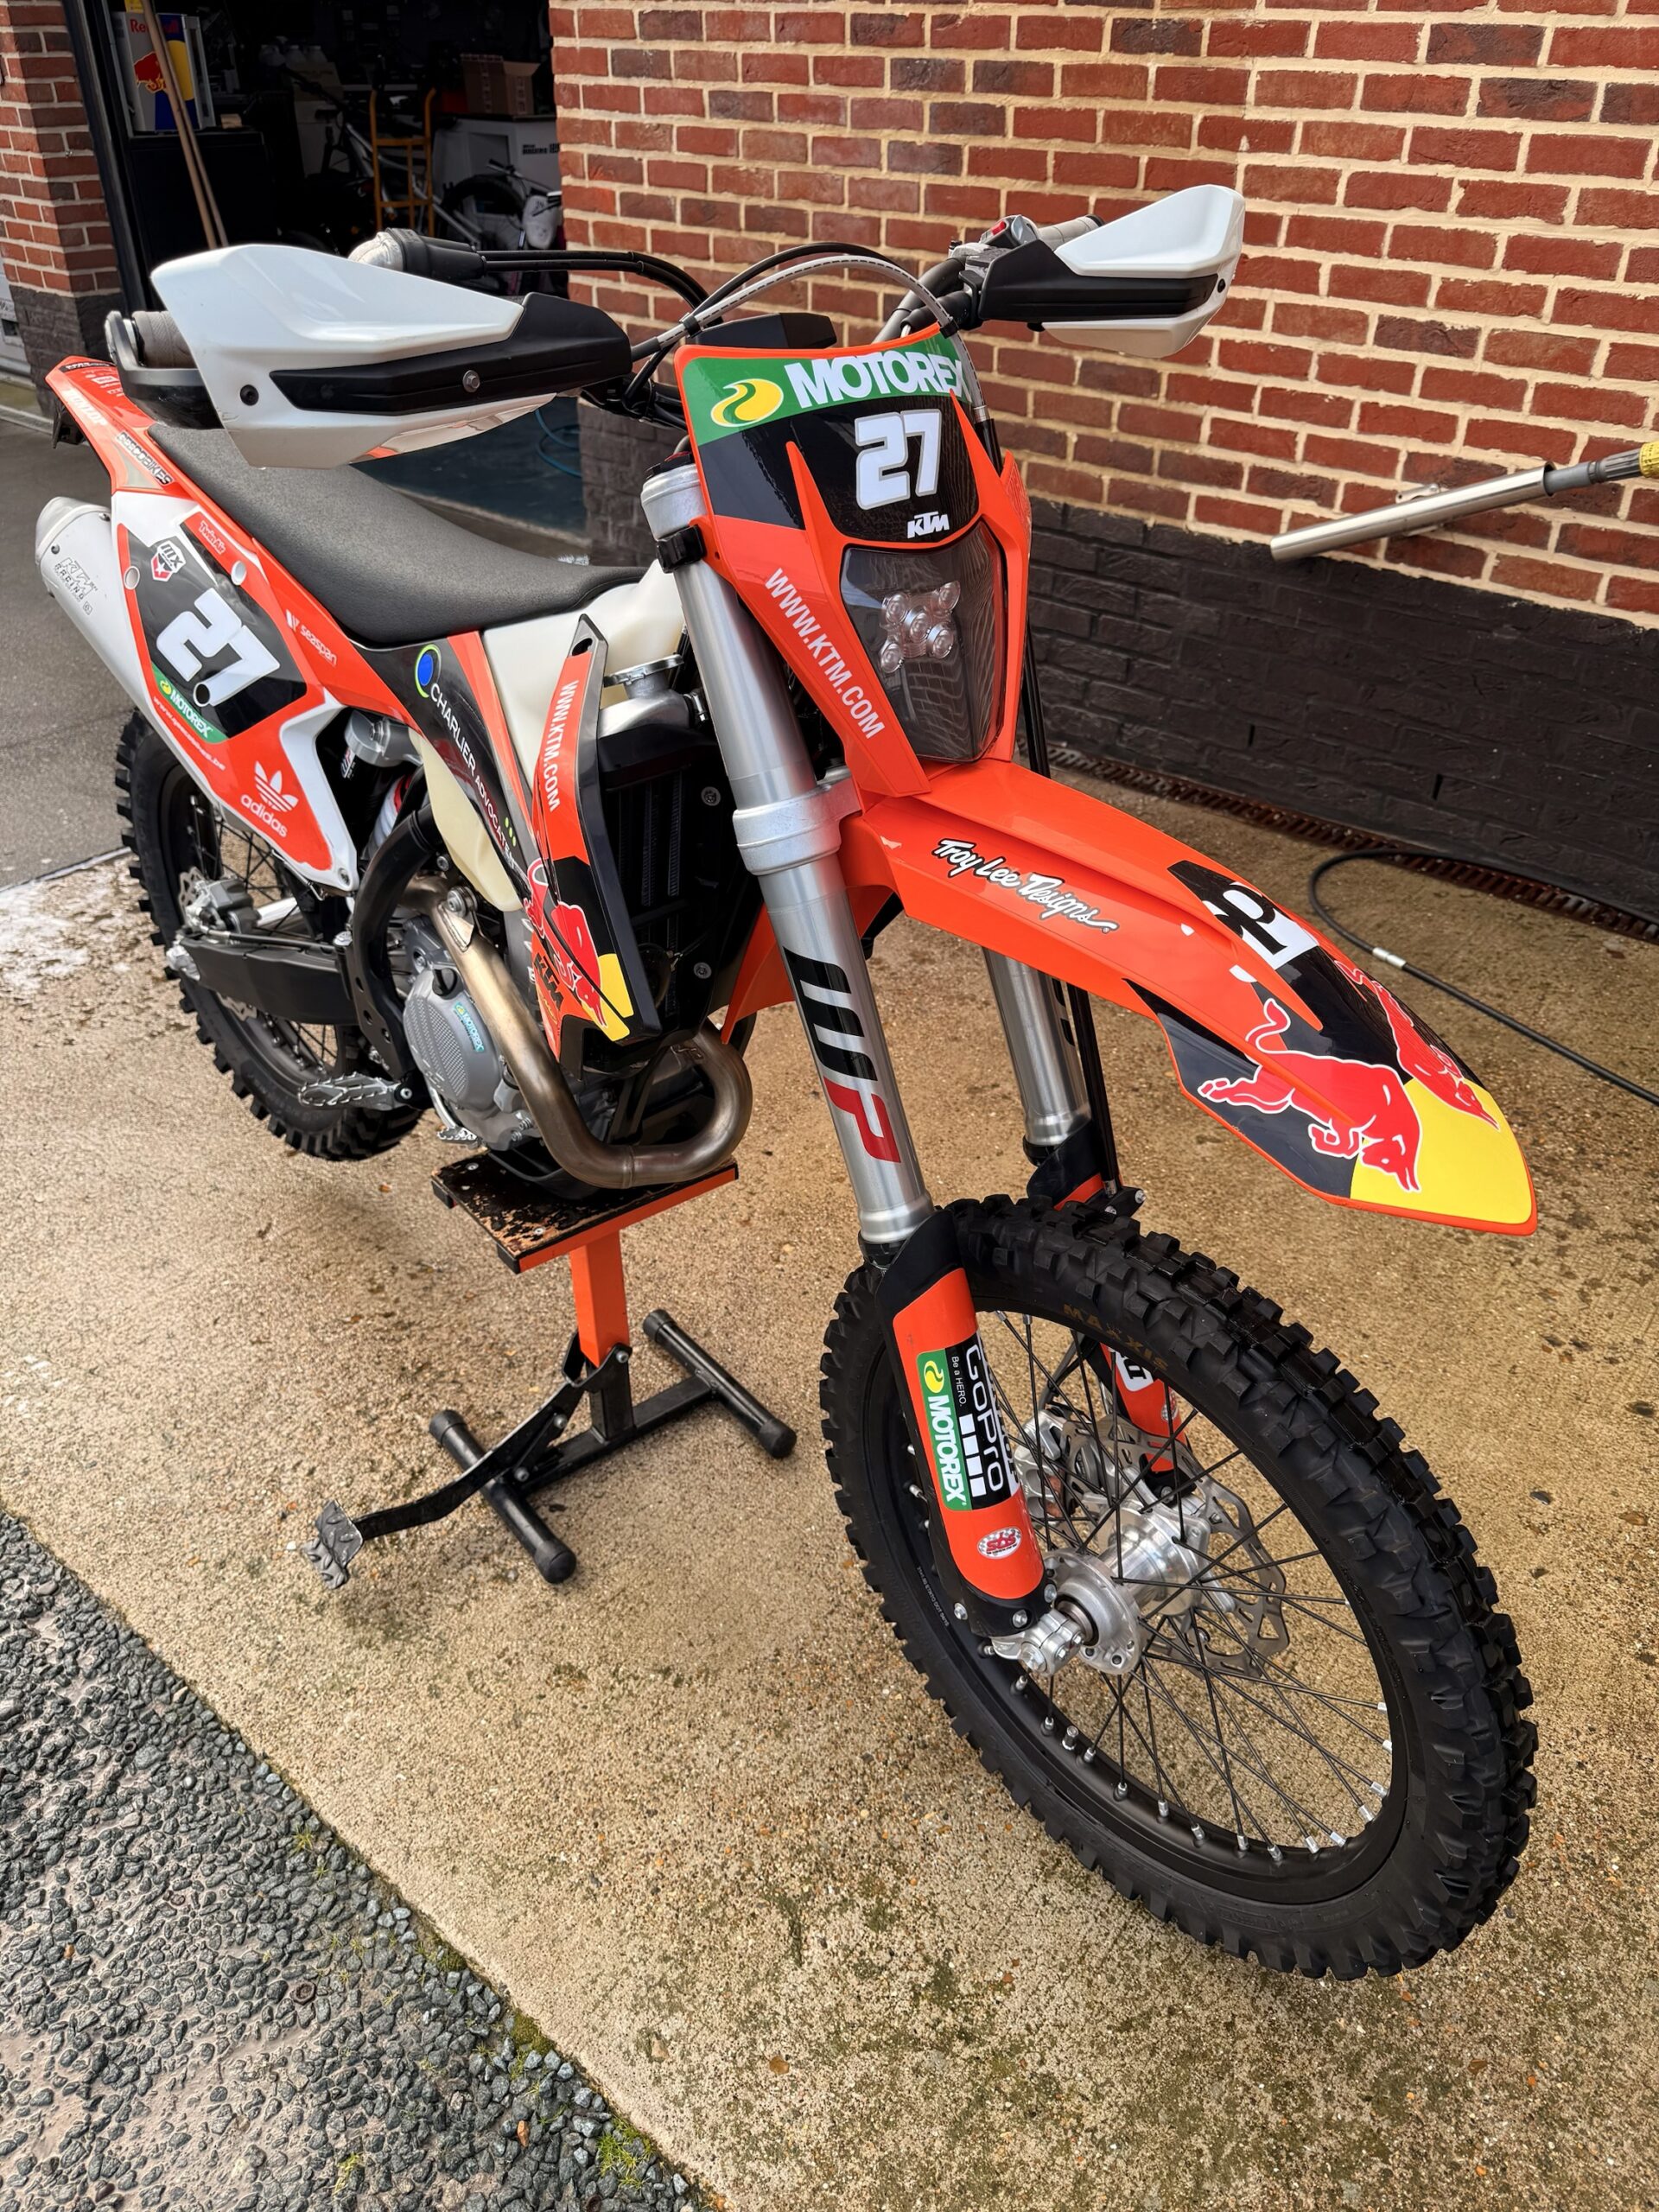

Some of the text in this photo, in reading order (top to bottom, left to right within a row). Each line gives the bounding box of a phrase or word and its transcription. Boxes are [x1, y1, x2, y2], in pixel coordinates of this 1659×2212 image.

[130, 19, 149, 33] Re
[784, 350, 972, 409] MOTOREX
[855, 409, 942, 510] 27
[907, 512, 950, 538] KTM
[60, 557, 94, 596] KTM
[156, 588, 281, 707] 27
[765, 568, 885, 739] WWW.KTM.COM
[170, 690, 213, 739] MOTOREX
[431, 683, 476, 777] CHARLIER
[543, 680, 579, 812] WWW.KTM.COM
[240, 794, 288, 837] adidas
[932, 838, 1119, 931] Troy Lee Designs
[534, 952, 563, 1011] KTM
[928, 1395, 966, 1504] MOTOREX
